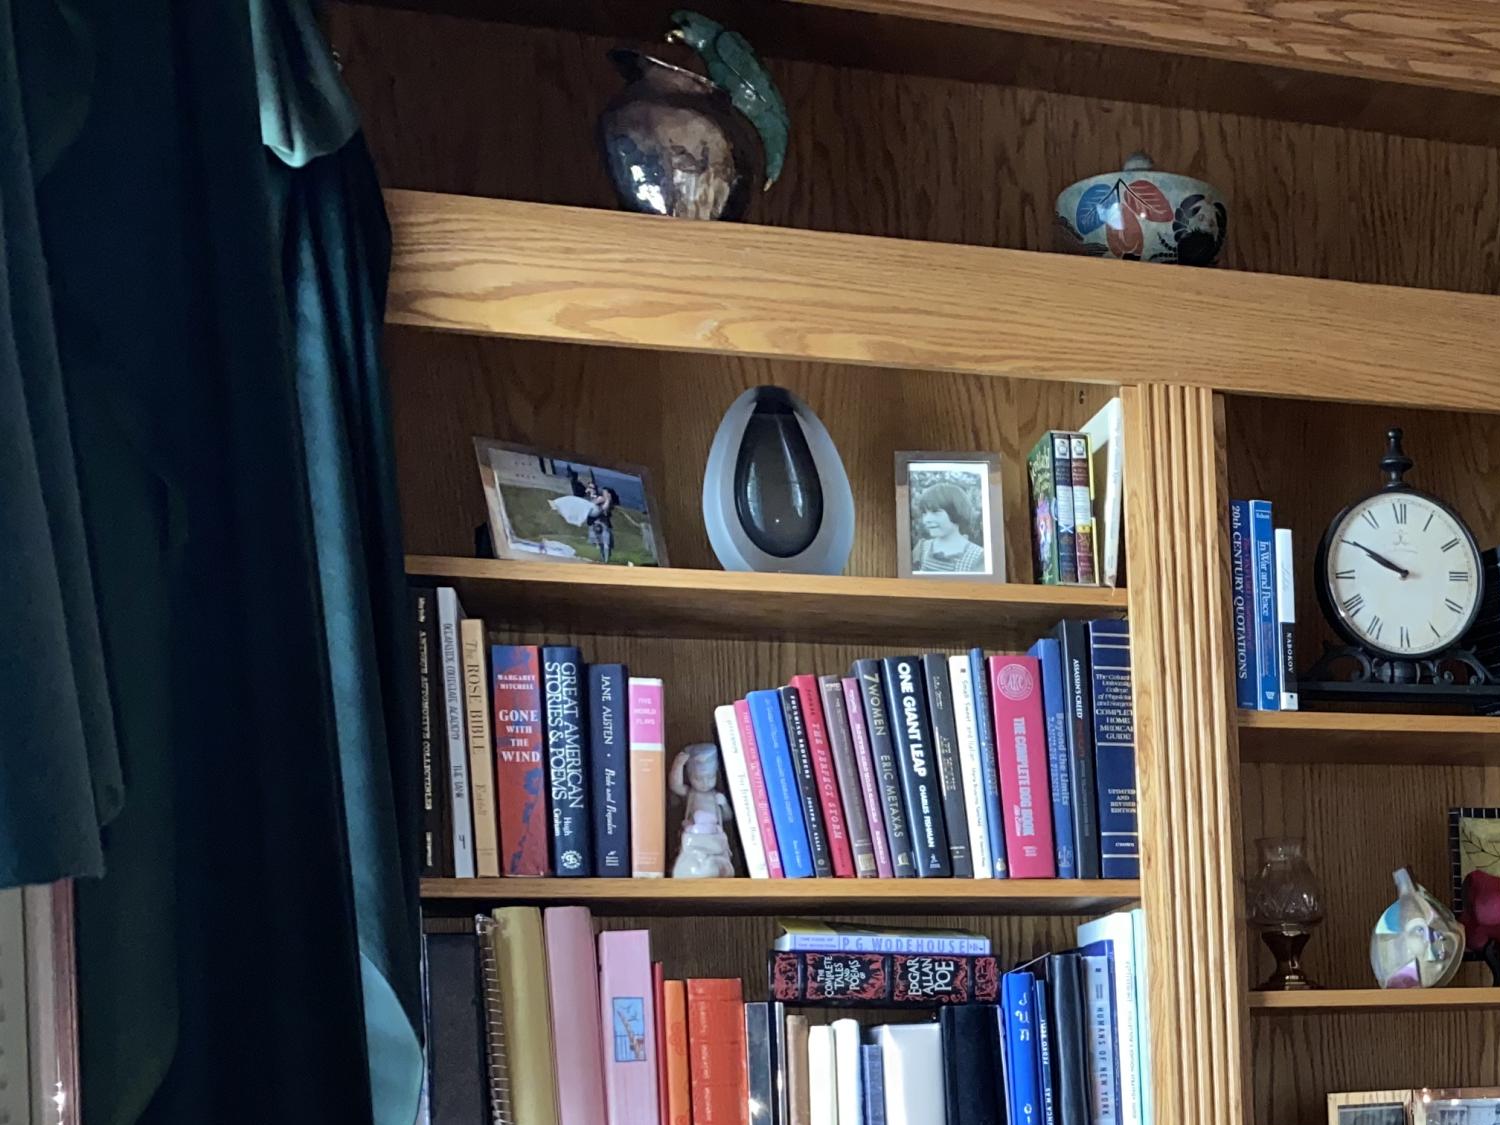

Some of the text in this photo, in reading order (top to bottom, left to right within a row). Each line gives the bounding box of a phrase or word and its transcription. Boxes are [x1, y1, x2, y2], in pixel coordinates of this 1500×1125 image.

[1259, 541, 1268, 551] In
[1260, 552, 1269, 570] War
[1232, 505, 1247, 679] 20th CENTURY QUOTATIONS
[1261, 571, 1269, 589] and
[1262, 591, 1270, 616] Peace
[1286, 632, 1294, 673] NABOKOV
[466, 663, 482, 704] ROSE
[863, 672, 886, 736] 7 WOMEN
[1073, 659, 1083, 719] ASSASSIN'S CREED
[498, 709, 539, 722] GONE
[505, 725, 533, 734] WITH
[601, 674, 613, 745] JANE AUSTEN
[898, 662, 927, 778] ONE GIANT LEAP
[469, 709, 485, 755] BIBLE
[510, 738, 529, 747] THE
[545, 662, 567, 800] STORIES & POEMS
[560, 662, 584, 809] GREAT AMERICAN
[501, 751, 540, 763] WIND
[798, 738, 811, 779] BROTHERS
[1013, 717, 1034, 836] THE COMPLETE DOG BOOK
[1055, 712, 1070, 806] Beyond the Limits
[606, 788, 616, 803] and
[812, 722, 842, 840] THE PERFECT STORM
[880, 754, 904, 838] ERIC METAXAS
[562, 816, 572, 836] Hugh
[919, 784, 934, 848] CHARLES FISHMAN
[871, 938, 967, 953] WODEHOUSE
[817, 969, 825, 982] THE
[824, 955, 833, 998] COMPLETE
[835, 962, 844, 988] TALES
[849, 959, 861, 991] POEMS
[908, 958, 922, 995] EDGAR
[922, 958, 933, 995] ALLAN
[934, 961, 954, 991] POE
[1095, 1006, 1110, 1116] HUMANS OF NEW YORK
